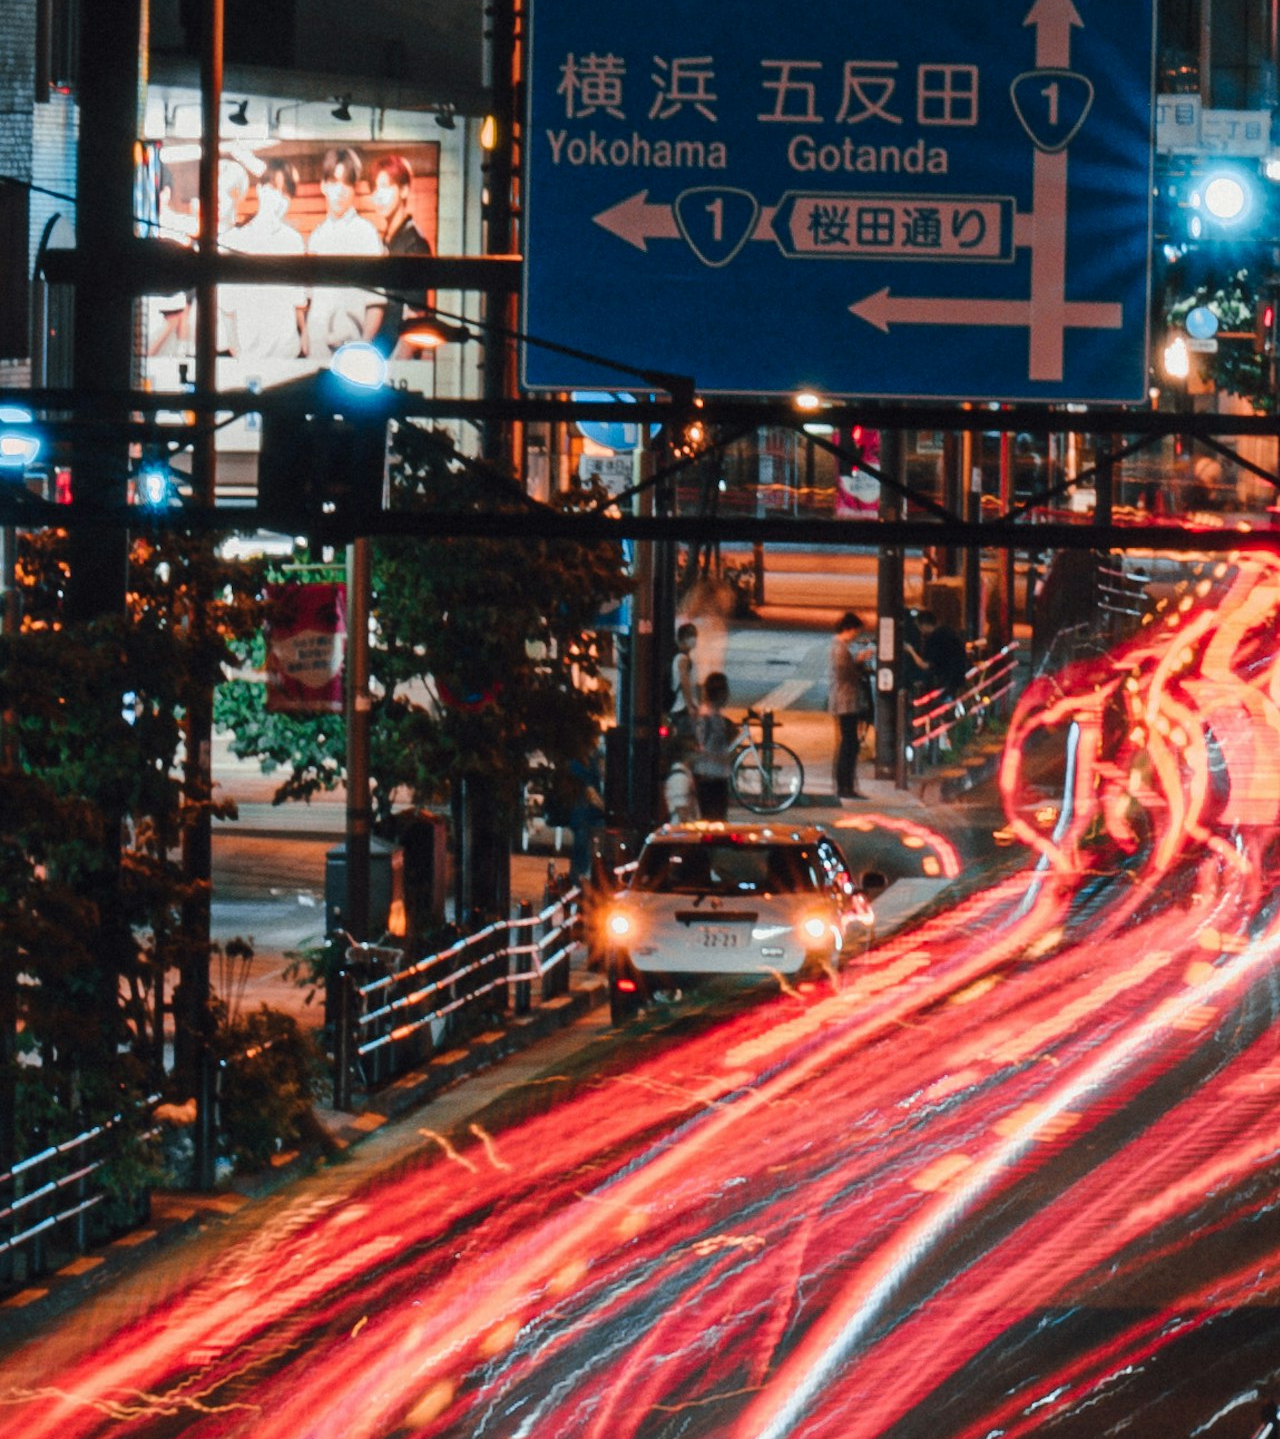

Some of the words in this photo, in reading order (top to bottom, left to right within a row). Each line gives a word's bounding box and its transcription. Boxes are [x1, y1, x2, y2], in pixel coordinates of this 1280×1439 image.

[556, 52, 718, 122] 横浜
[757, 59, 979, 126] 五反田
[1041, 82, 1059, 125] 1
[546, 128, 727, 169] Yokohama
[787, 134, 949, 174] Gotanda
[705, 197, 723, 242] 1
[807, 203, 987, 249] 桜田通り
